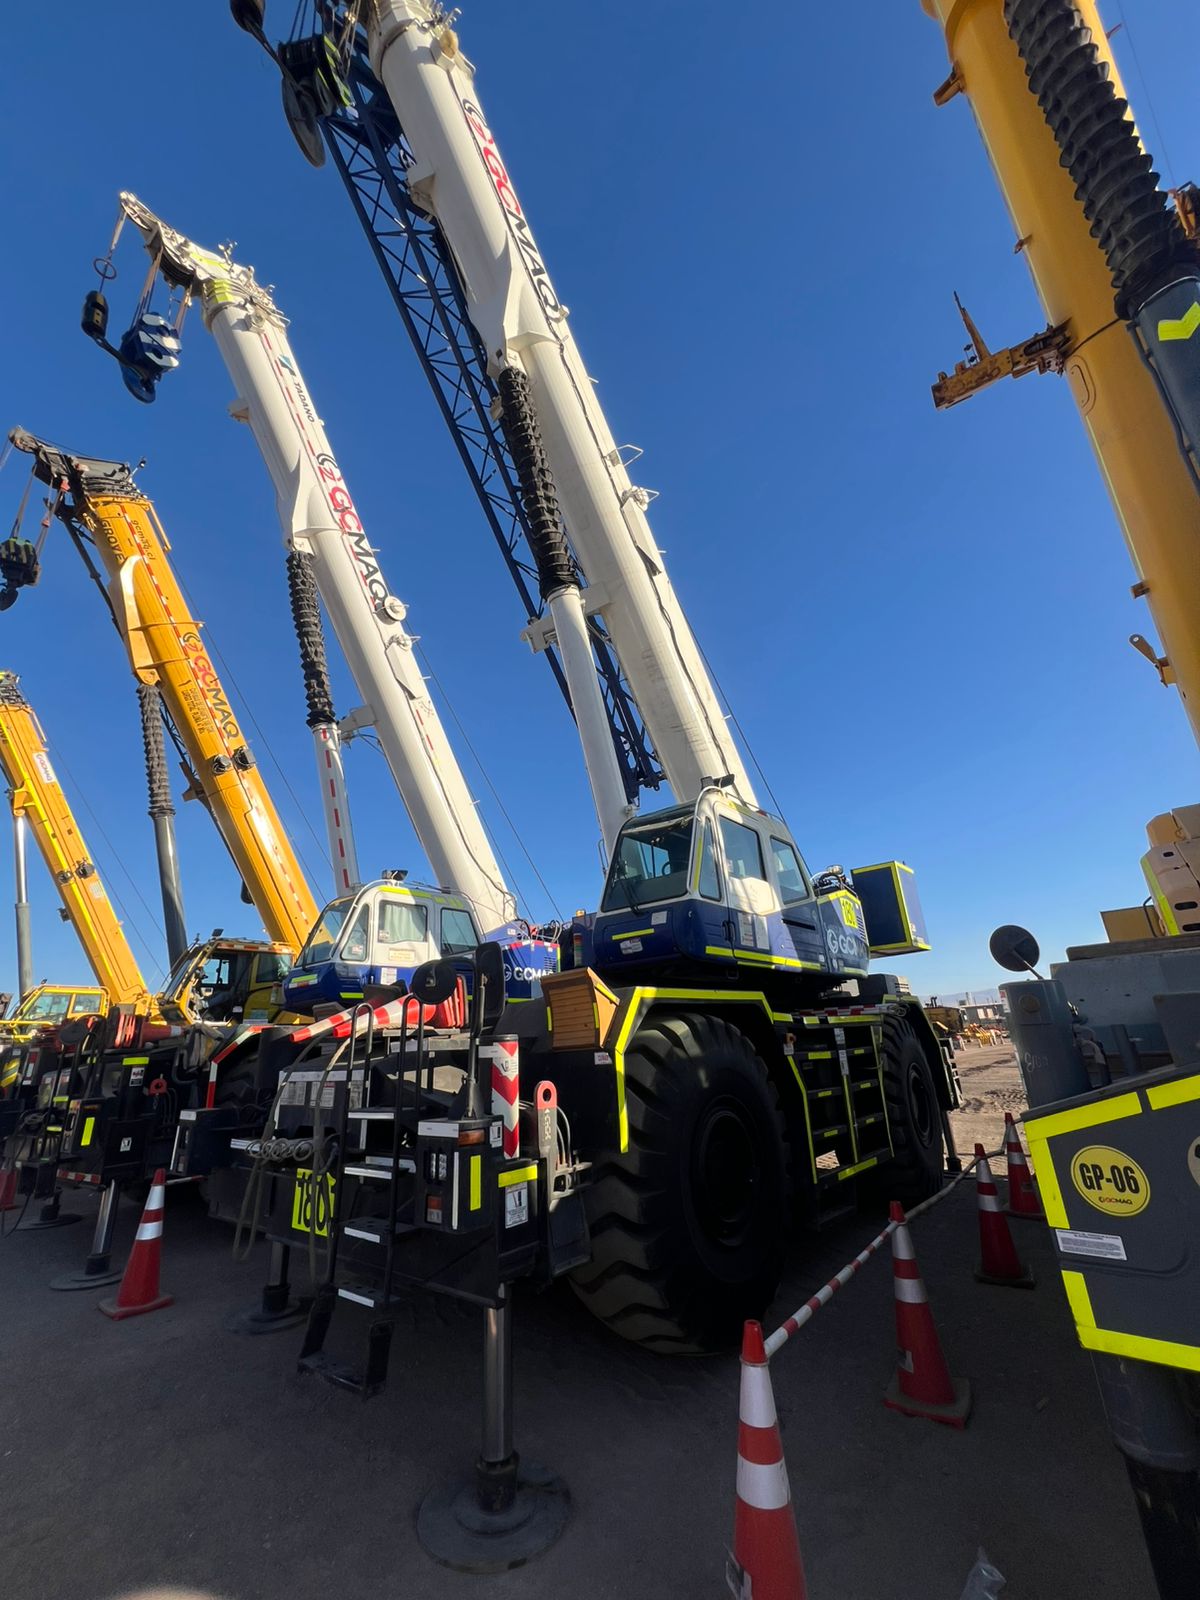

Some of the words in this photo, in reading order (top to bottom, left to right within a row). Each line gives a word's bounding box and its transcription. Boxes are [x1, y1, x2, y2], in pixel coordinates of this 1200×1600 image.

[483, 146, 562, 315] GCMAQ
[294, 382, 315, 422] TADANO
[329, 486, 389, 609] GCMAQ
[194, 655, 240, 739] GCMAQ
[1079, 1163, 1140, 1194] GP-06
